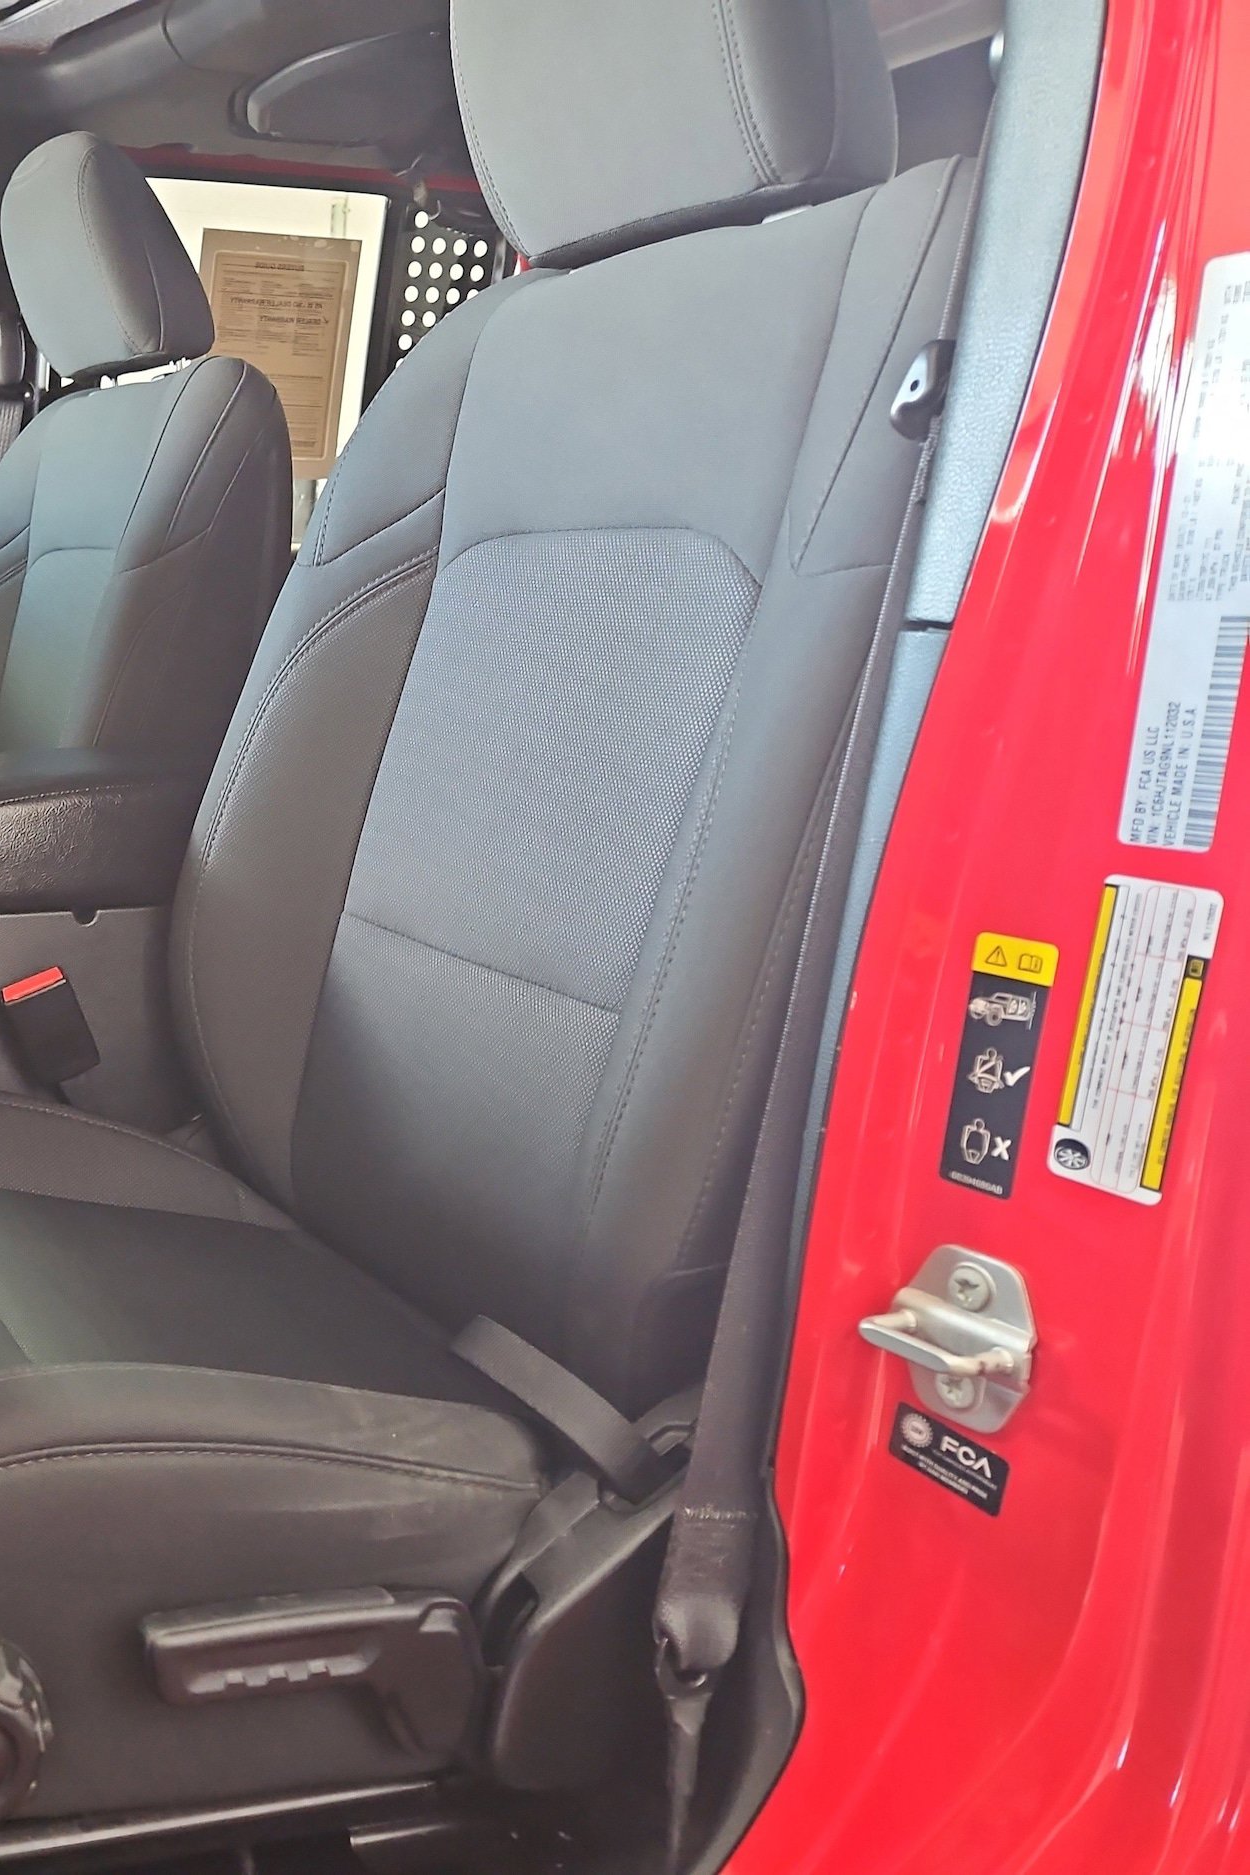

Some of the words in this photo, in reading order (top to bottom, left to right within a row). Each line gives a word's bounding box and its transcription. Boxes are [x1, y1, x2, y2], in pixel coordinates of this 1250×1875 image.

[1146, 726, 1159, 746] LLC
[1143, 750, 1155, 765] US
[1139, 769, 1151, 790] FCA
[1171, 764, 1187, 795] MADE
[1163, 800, 1181, 846] VEHICLE
[940, 1435, 992, 1479] FCA
